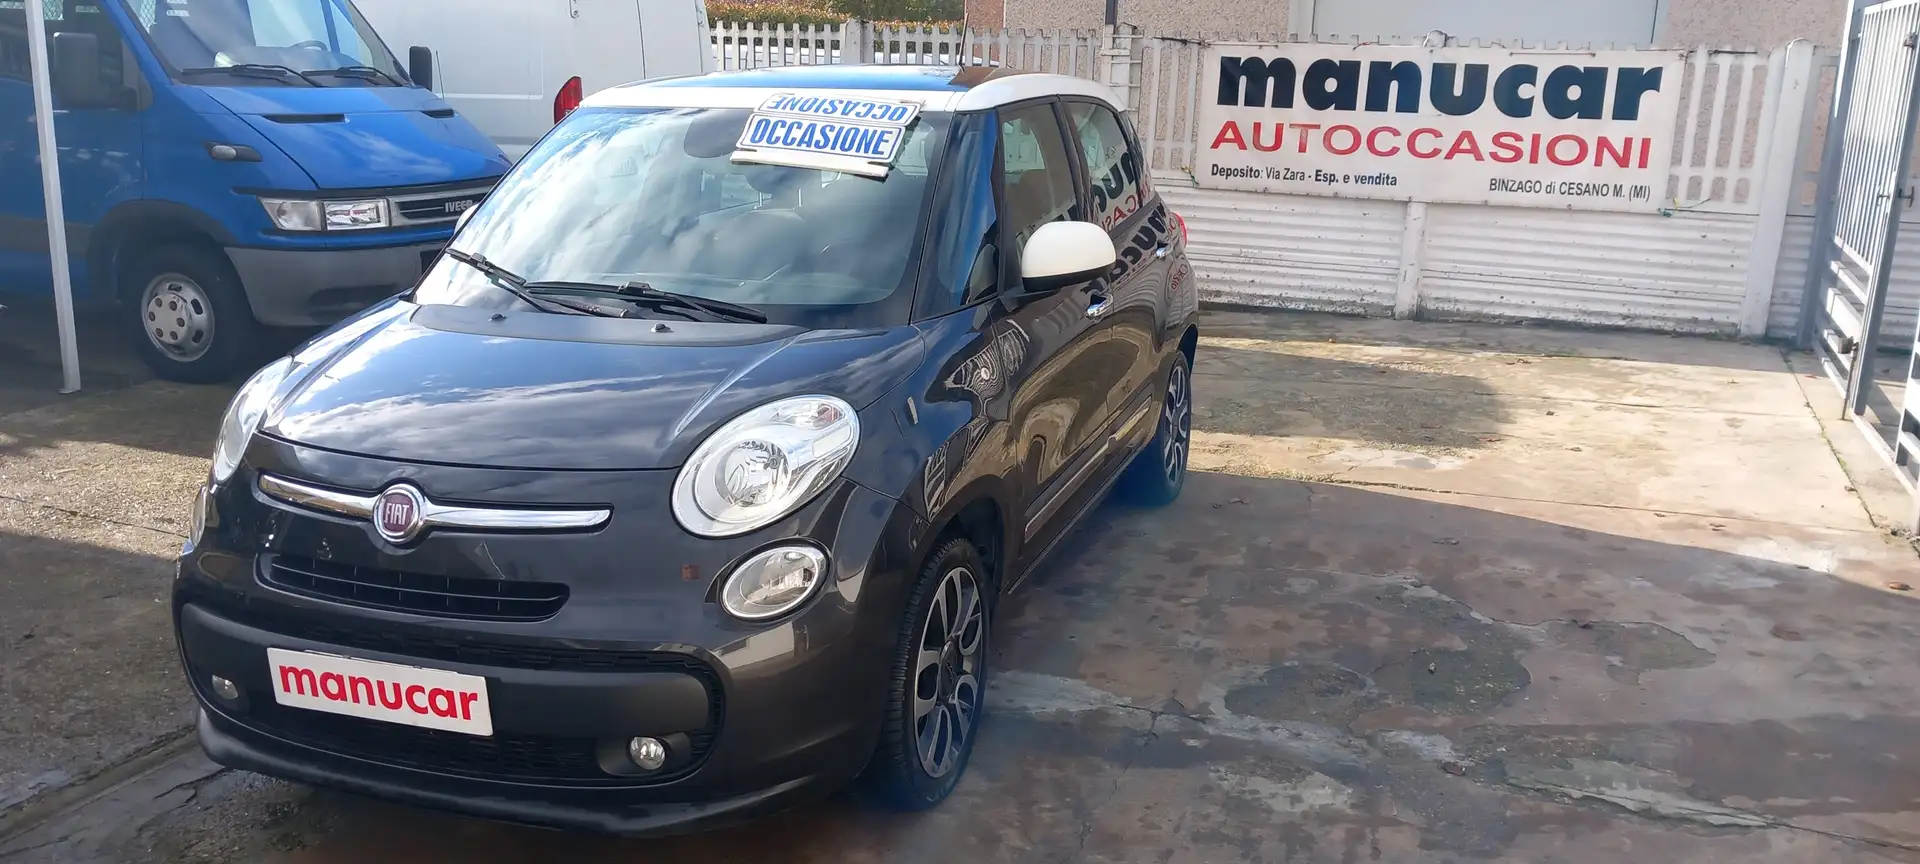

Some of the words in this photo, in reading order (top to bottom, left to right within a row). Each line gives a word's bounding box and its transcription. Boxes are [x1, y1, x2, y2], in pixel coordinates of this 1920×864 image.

[1217, 56, 1663, 121] manucar
[767, 96, 908, 122] OCCASIONE
[750, 118, 893, 156] OCCASIONE
[1210, 120, 1652, 169] AUTOCCASIONI
[1211, 163, 1263, 179] Deposito:
[1266, 167, 1280, 180] Via
[1283, 168, 1305, 181] Zara
[1315, 169, 1339, 184] Esp.
[1343, 173, 1350, 183] e
[1354, 173, 1397, 186] vendita
[1489, 178, 1542, 193] BINZAGO
[1545, 181, 1556, 194] di
[1559, 182, 1609, 196] CESANO
[1612, 184, 1626, 198] M.
[1629, 185, 1651, 203] (MI)
[384, 502, 410, 525] FIAT
[279, 665, 478, 720] manucar
